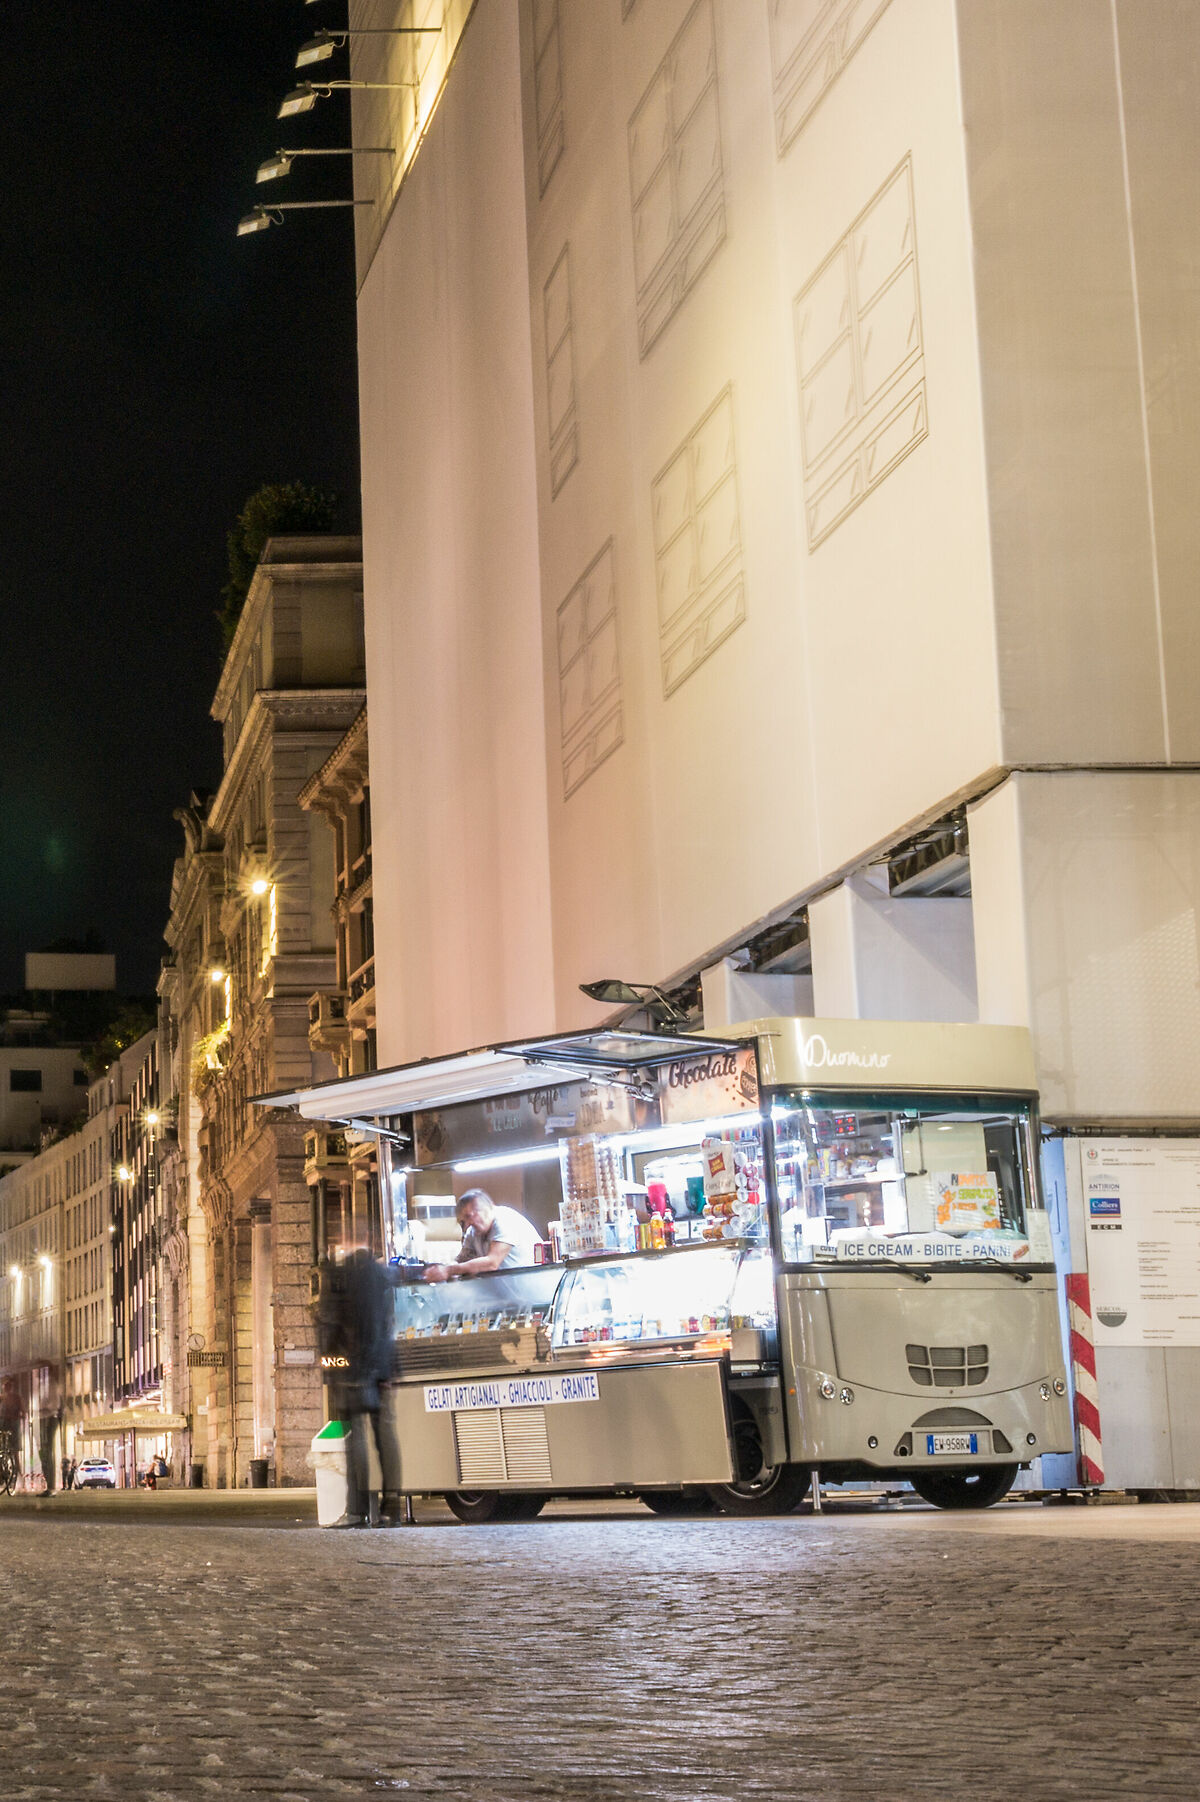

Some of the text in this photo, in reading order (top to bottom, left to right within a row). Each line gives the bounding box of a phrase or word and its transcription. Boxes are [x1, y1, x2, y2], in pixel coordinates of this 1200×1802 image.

[803, 1033, 891, 1068] Duomino
[1092, 1200, 1118, 1209] Colliers
[844, 1243, 865, 1257] ICE
[868, 1243, 913, 1257] CREAM
[924, 1244, 962, 1257] BIBITE
[428, 1388, 453, 1409] GELATI
[455, 1384, 500, 1408] ARTIGIANALI
[509, 1379, 552, 1404] GHIACCIOLI
[561, 1376, 597, 1400] GRANITE
